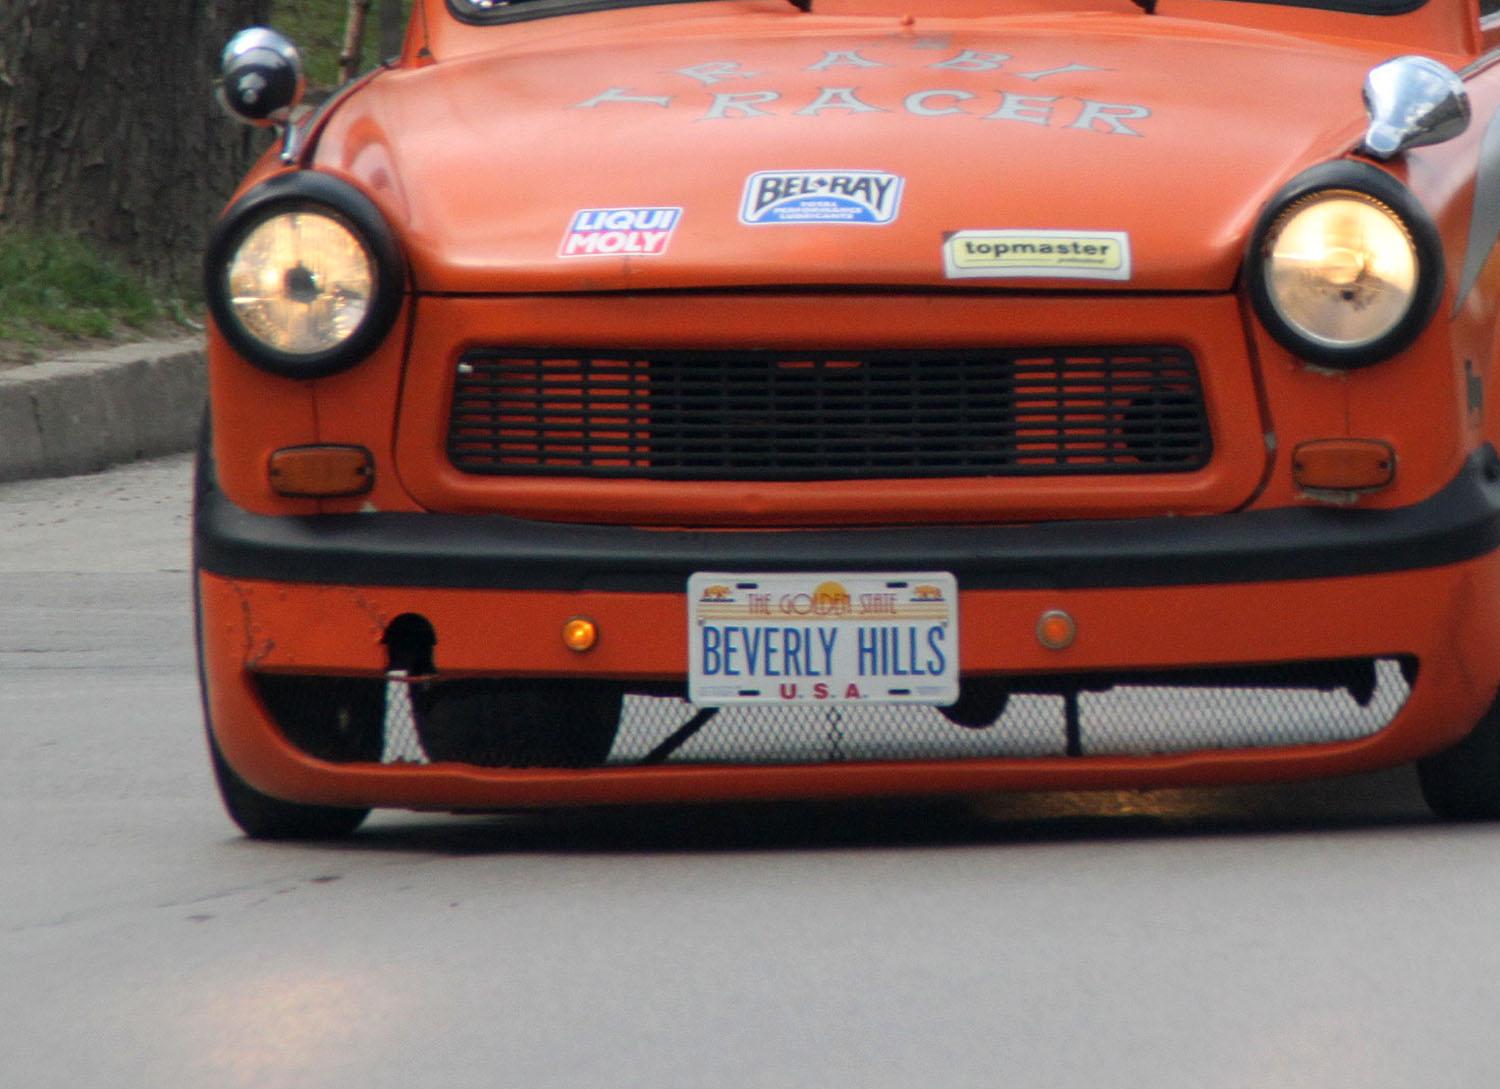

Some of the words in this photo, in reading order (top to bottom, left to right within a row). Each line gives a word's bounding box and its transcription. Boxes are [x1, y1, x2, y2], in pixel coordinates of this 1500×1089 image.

[574, 210, 677, 231] LIQUI
[565, 231, 668, 254] MOLY
[966, 240, 1110, 258] topmaster
[747, 593, 771, 614] THE
[779, 593, 851, 615] GOLDEN
[859, 593, 898, 614] STATE
[703, 626, 838, 676] BEVERLY
[858, 625, 947, 676] HILLS
